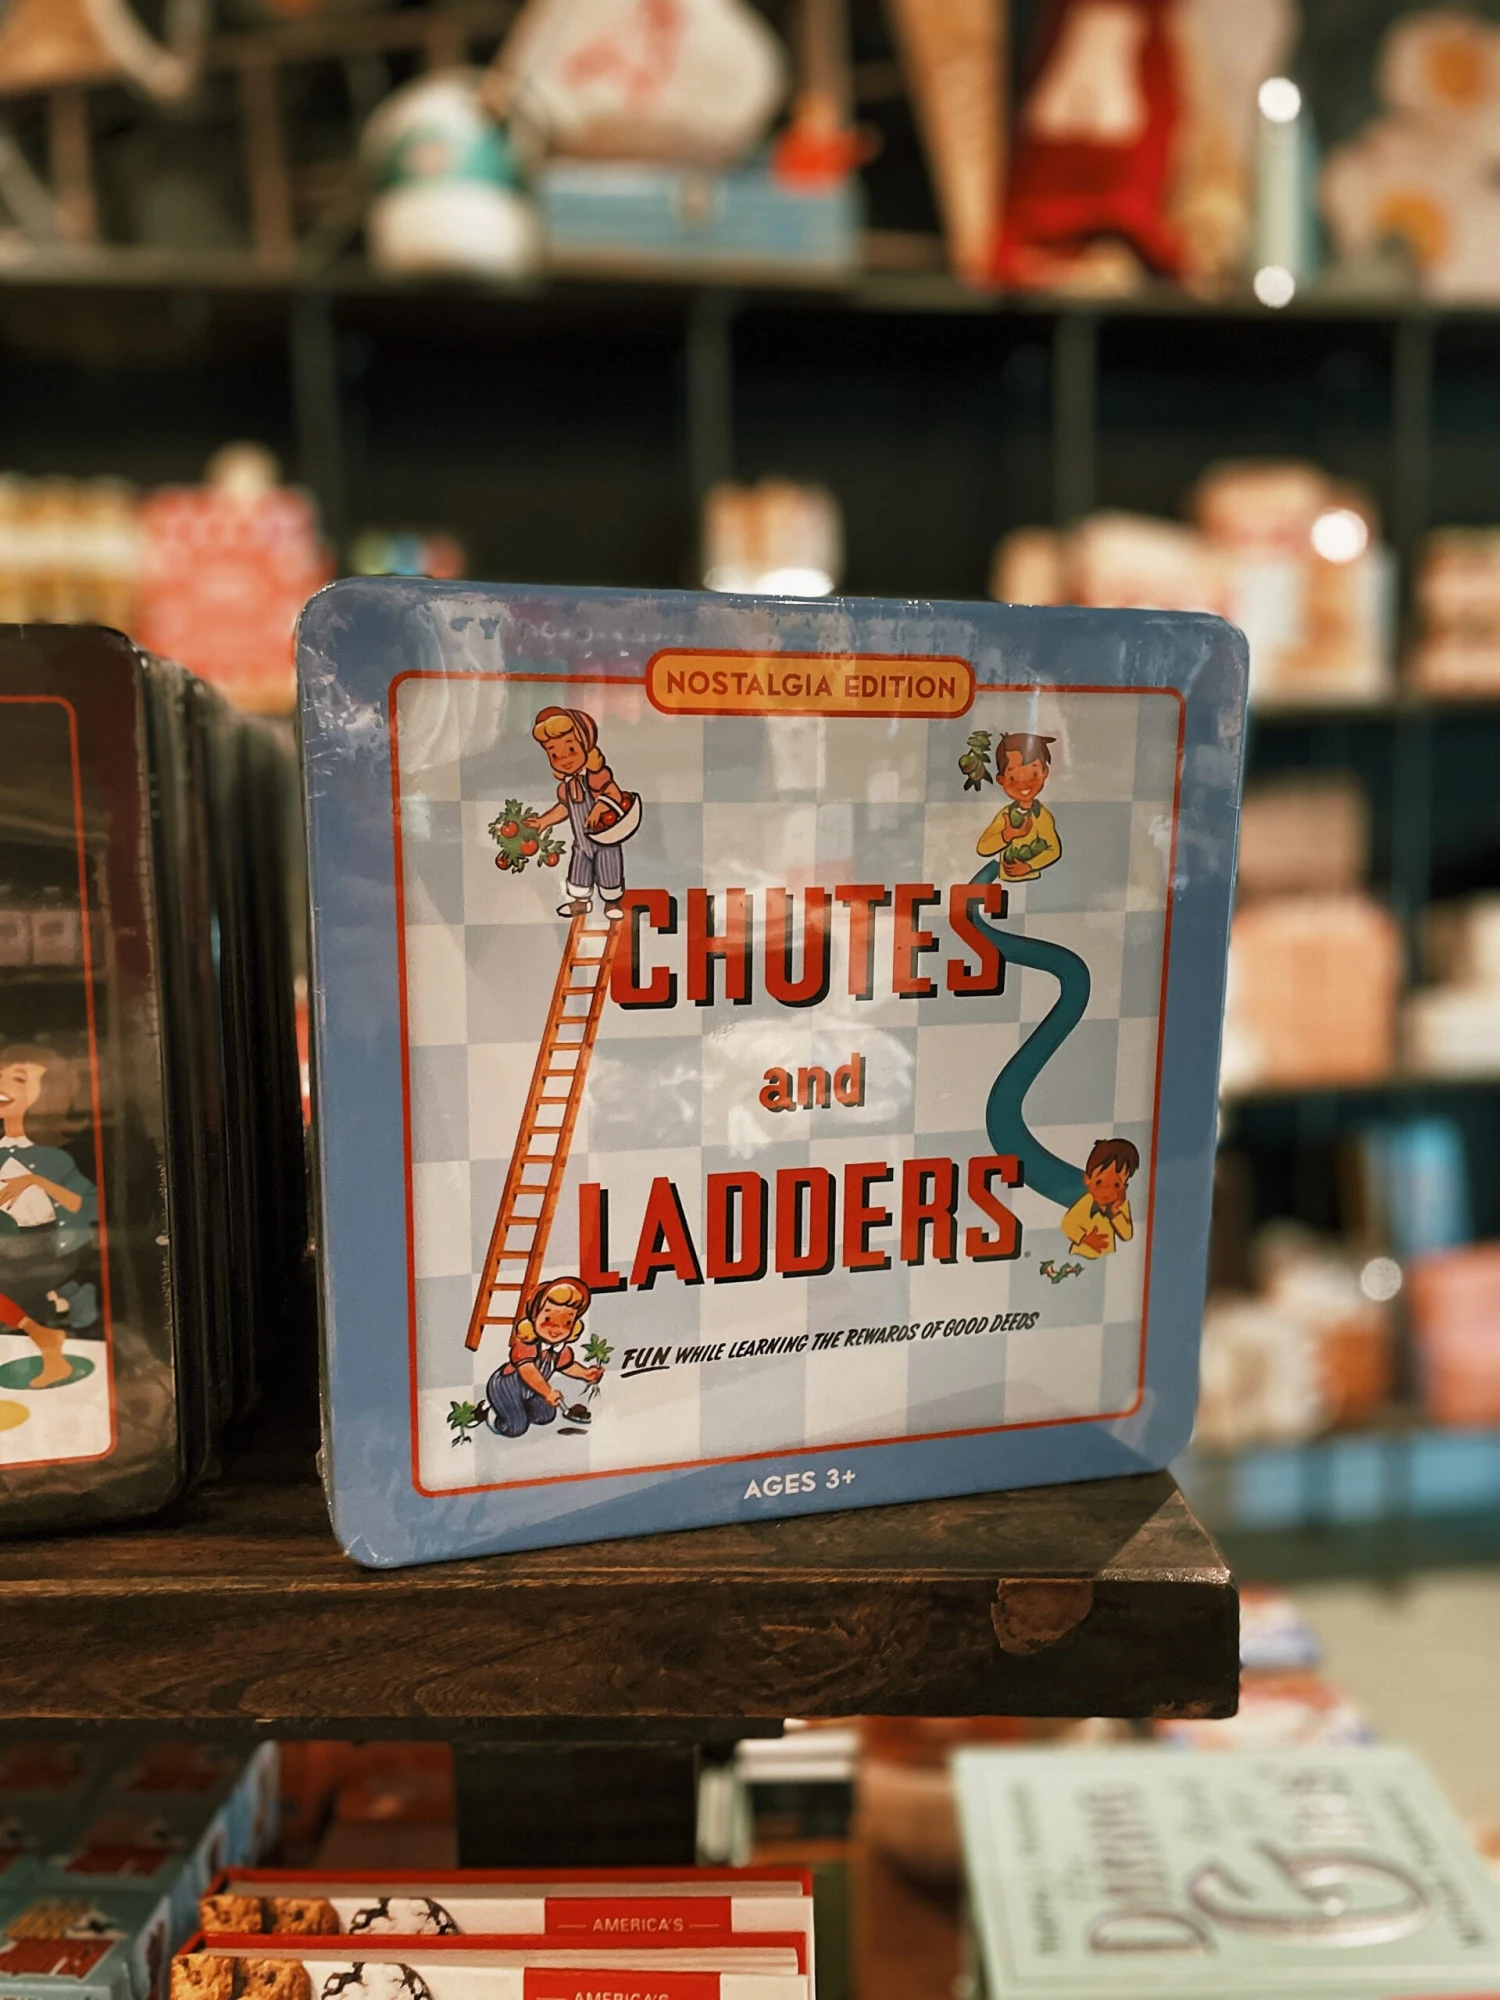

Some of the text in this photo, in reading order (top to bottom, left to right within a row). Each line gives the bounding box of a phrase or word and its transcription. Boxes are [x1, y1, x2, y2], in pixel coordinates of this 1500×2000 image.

[667, 670, 956, 699] NOSTALGIA EDITION
[610, 884, 1009, 1008] CHUTES
[759, 1052, 866, 1112] and
[578, 1154, 1025, 1294] LADDERS
[621, 1312, 1040, 1370] FUN WHILE LEARNING THE REWARDS OF GOOD DEEDS
[743, 1468, 856, 1499] AGES 3+
[592, 1918, 684, 1932] AMERICA'S
